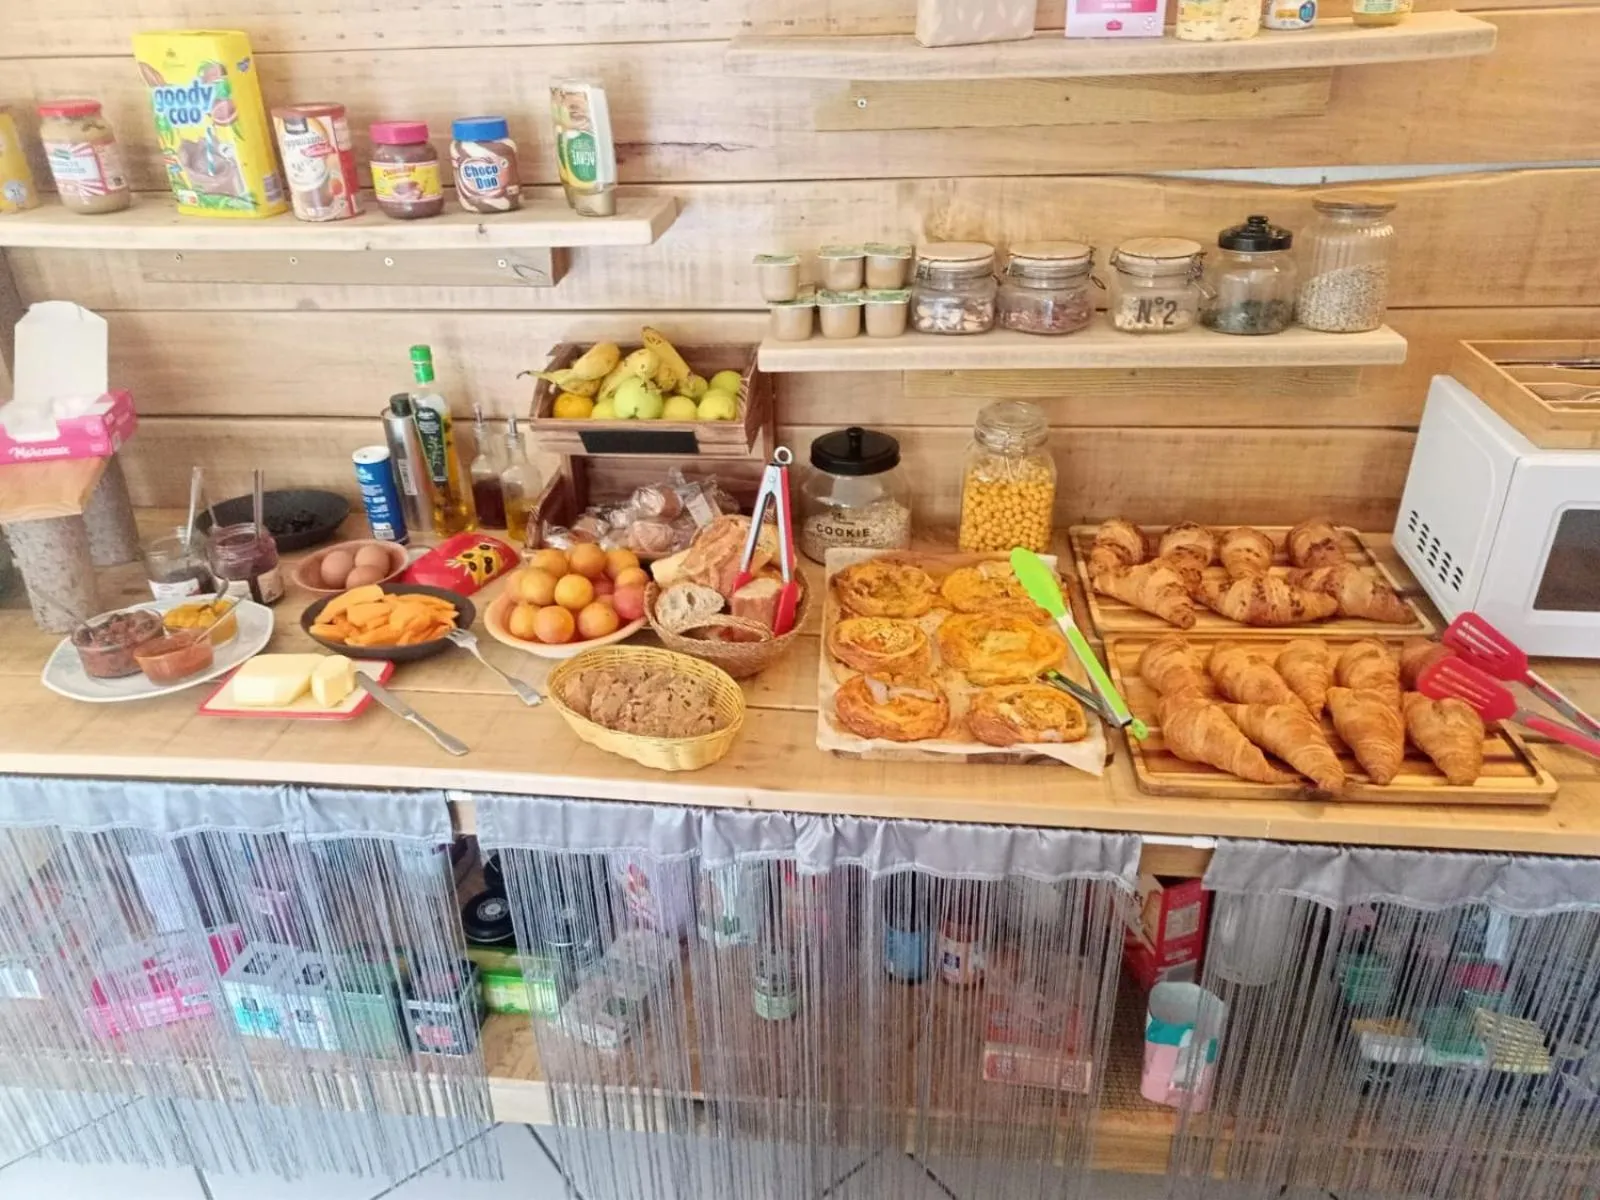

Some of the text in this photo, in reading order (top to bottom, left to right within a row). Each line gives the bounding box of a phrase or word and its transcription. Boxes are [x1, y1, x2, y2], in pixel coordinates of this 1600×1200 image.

[155, 80, 213, 112] goody
[169, 107, 201, 125] cao
[464, 165, 498, 177] Choco
[475, 177, 498, 189] Duo
[816, 523, 870, 537] COOKIE
